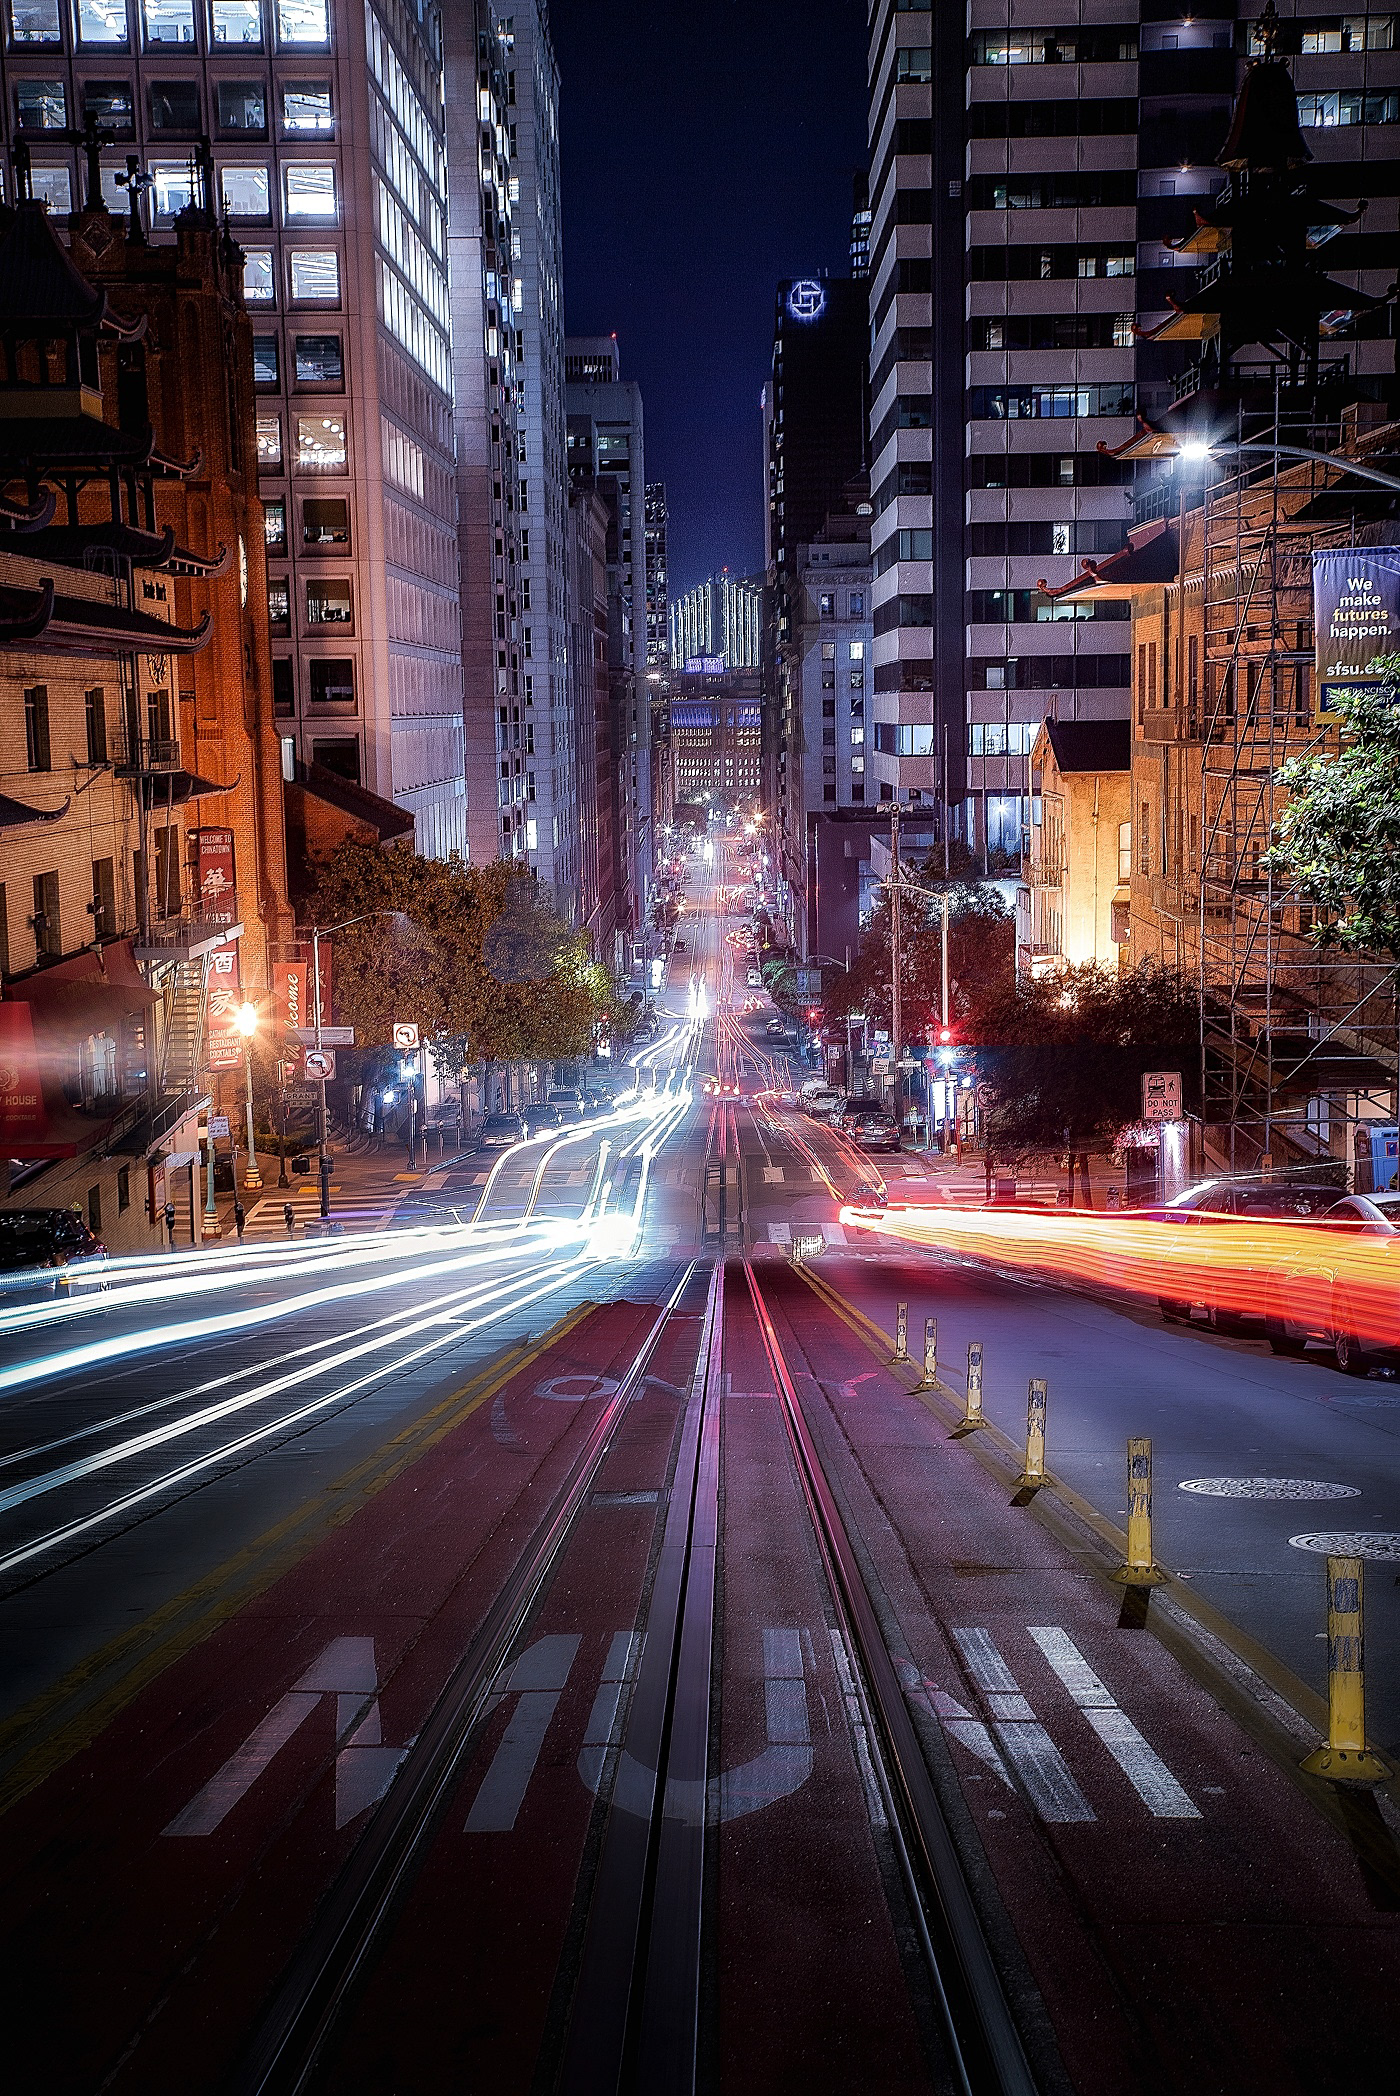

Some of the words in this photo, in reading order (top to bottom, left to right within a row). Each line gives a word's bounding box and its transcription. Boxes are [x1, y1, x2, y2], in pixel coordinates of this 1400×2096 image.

[1347, 577, 1373, 591] We
[1340, 592, 1381, 607] make
[1333, 608, 1389, 622] futures
[1330, 624, 1392, 640] happen.
[200, 834, 224, 844] WELCOME
[224, 834, 232, 843] TO
[201, 845, 231, 854] CHINATOWN
[5, 1096, 37, 1105] HOUSE
[533, 1372, 880, 1401] ONLY
[160, 1626, 1203, 1836] MUNI
